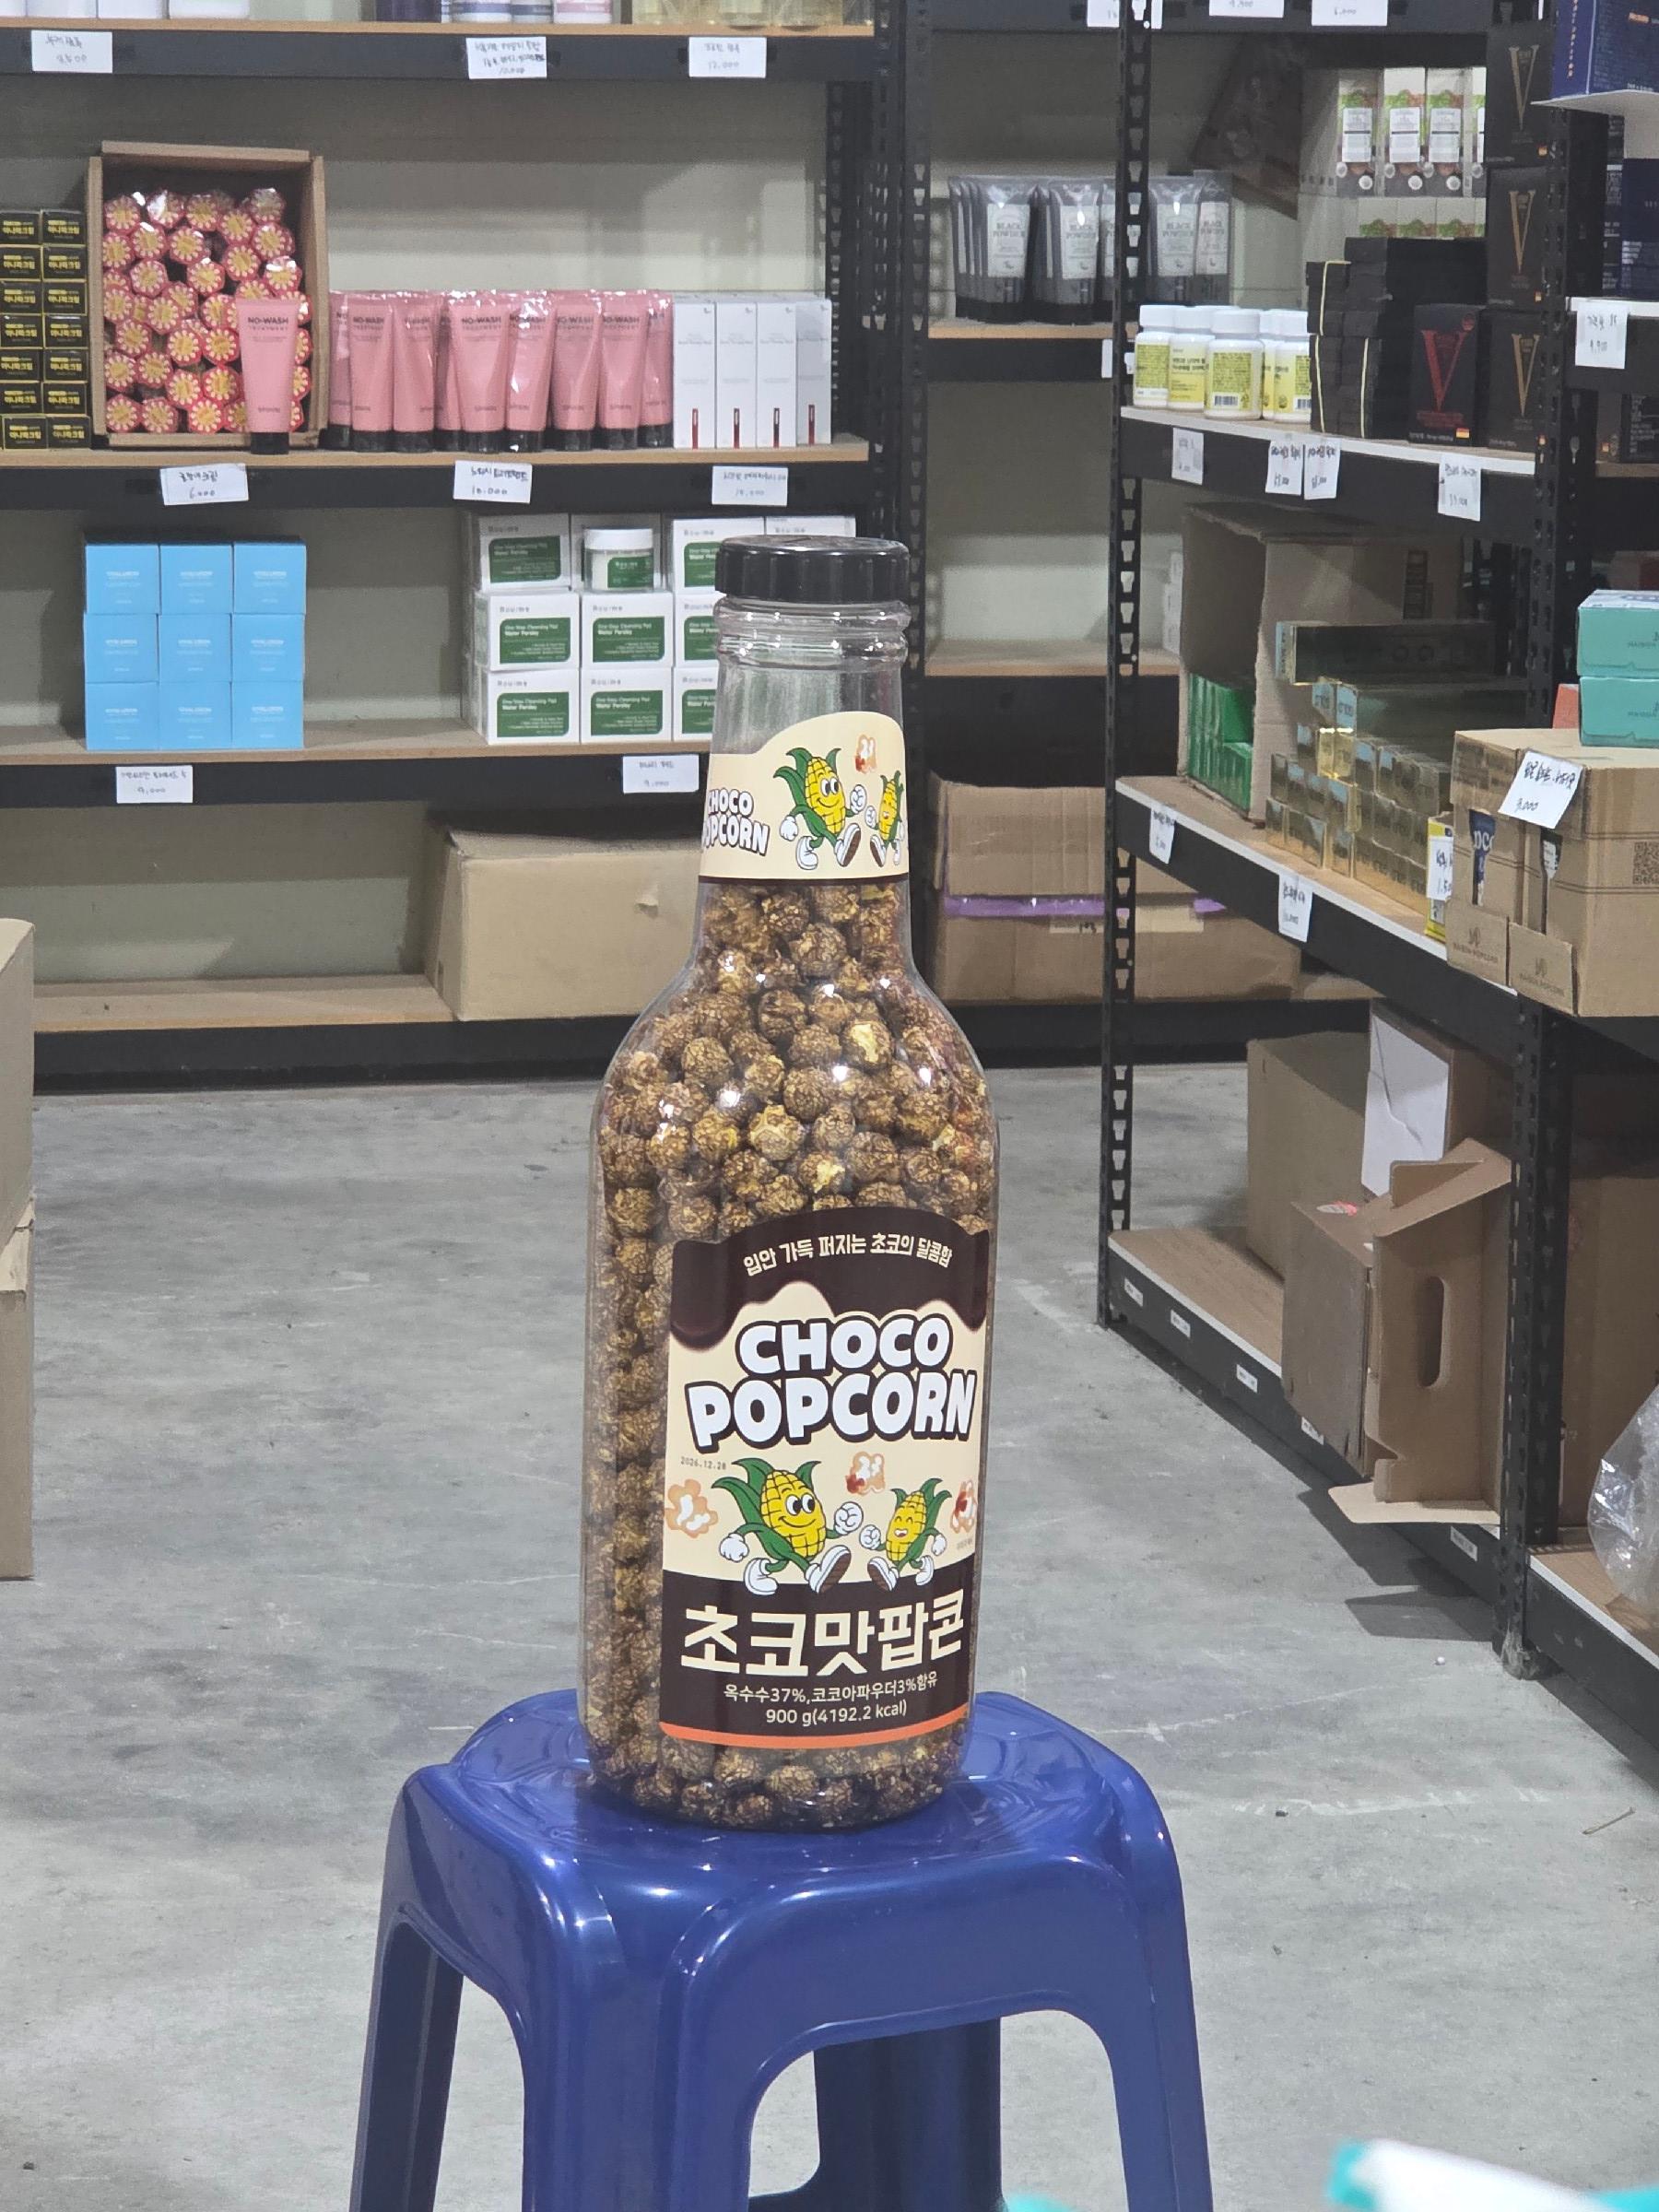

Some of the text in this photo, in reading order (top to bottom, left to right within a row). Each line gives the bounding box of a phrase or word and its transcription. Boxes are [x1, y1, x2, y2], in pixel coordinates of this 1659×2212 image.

[247, 316, 288, 324] NO-WASH
[461, 316, 501, 324] NO-WASH
[743, 1232, 953, 1277] 입안 가득 퍼지는 초코의 달콤함
[735, 1313, 953, 1378] CHOCO
[685, 1369, 977, 1453] POPCORN
[680, 1588, 964, 1677] 초코맛팝콘
[766, 1700, 908, 1727] 900 g(4192.2 kcal)
